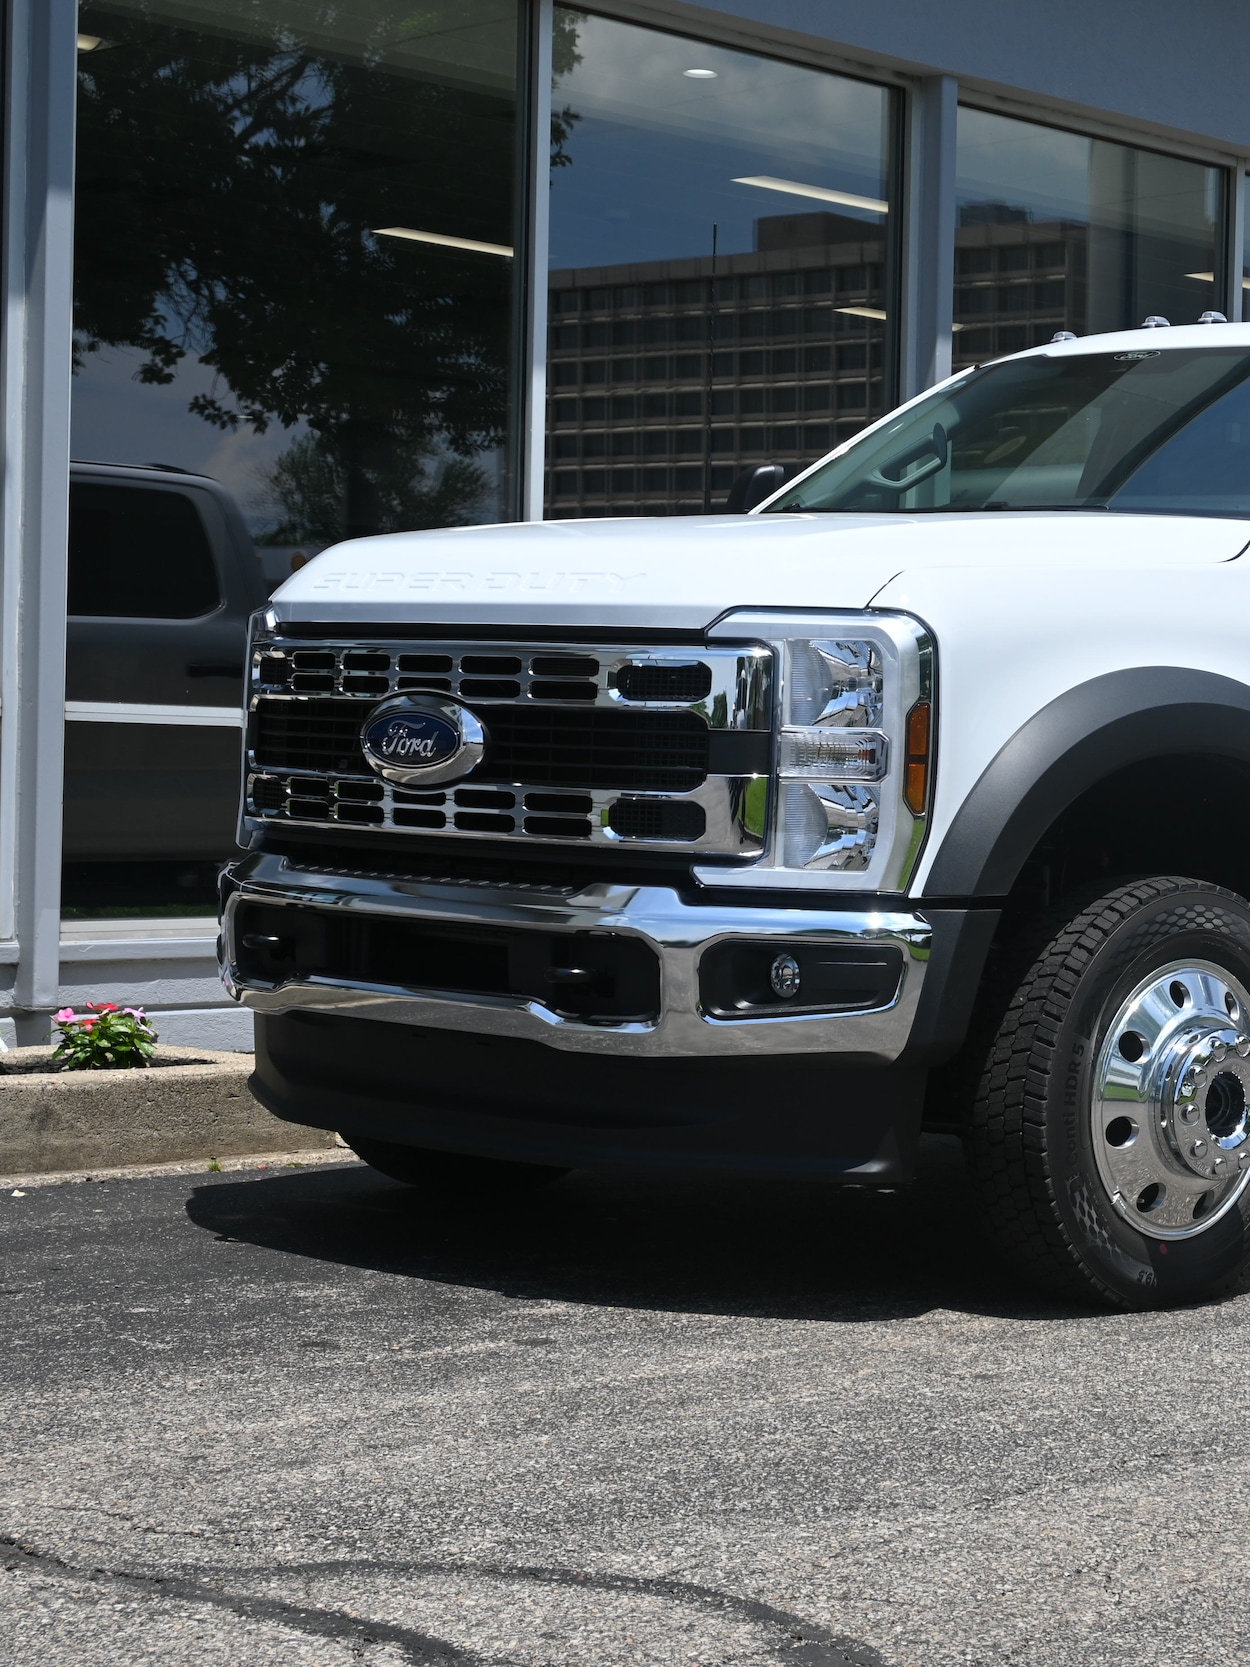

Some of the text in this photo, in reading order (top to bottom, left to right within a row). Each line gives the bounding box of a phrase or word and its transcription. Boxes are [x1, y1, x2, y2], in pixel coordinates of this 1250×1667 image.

[312, 572, 647, 593] SUPER DUTY
[382, 719, 440, 758] Ford
[1062, 1042, 1085, 1168] Conti HDR 5
